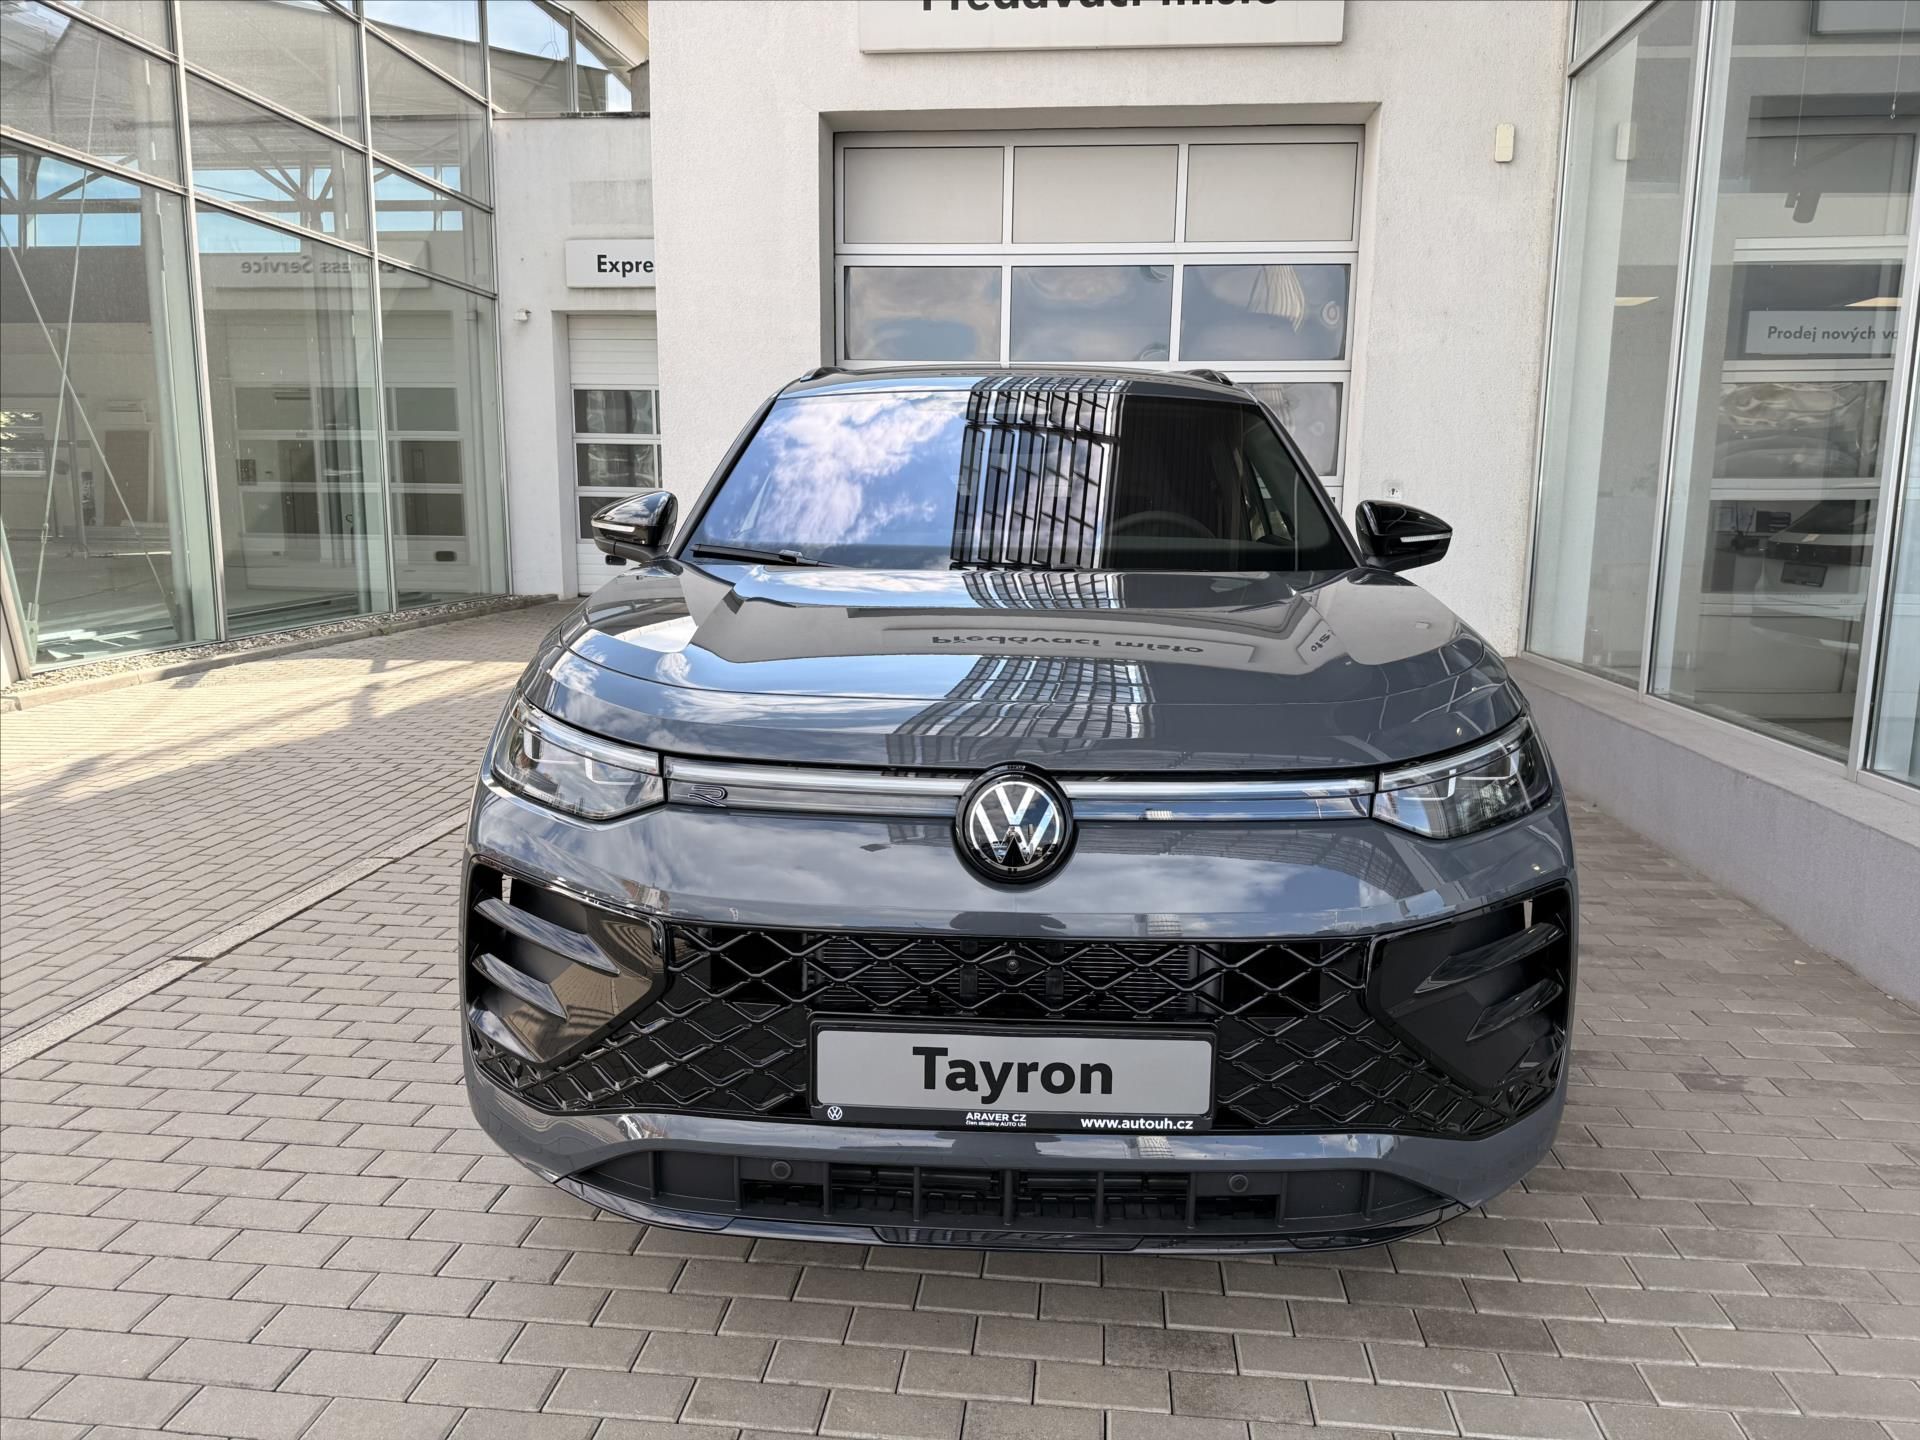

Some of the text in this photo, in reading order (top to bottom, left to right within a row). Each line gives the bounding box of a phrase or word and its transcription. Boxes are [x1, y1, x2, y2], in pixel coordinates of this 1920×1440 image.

[597, 254, 654, 278] Expre
[1767, 325, 1817, 343] Prodej
[1821, 325, 1876, 343] nových
[912, 1046, 1113, 1104] Tayron
[965, 1112, 1027, 1122] ARAVER CZ
[1080, 1117, 1194, 1129] www.autouh.cz
